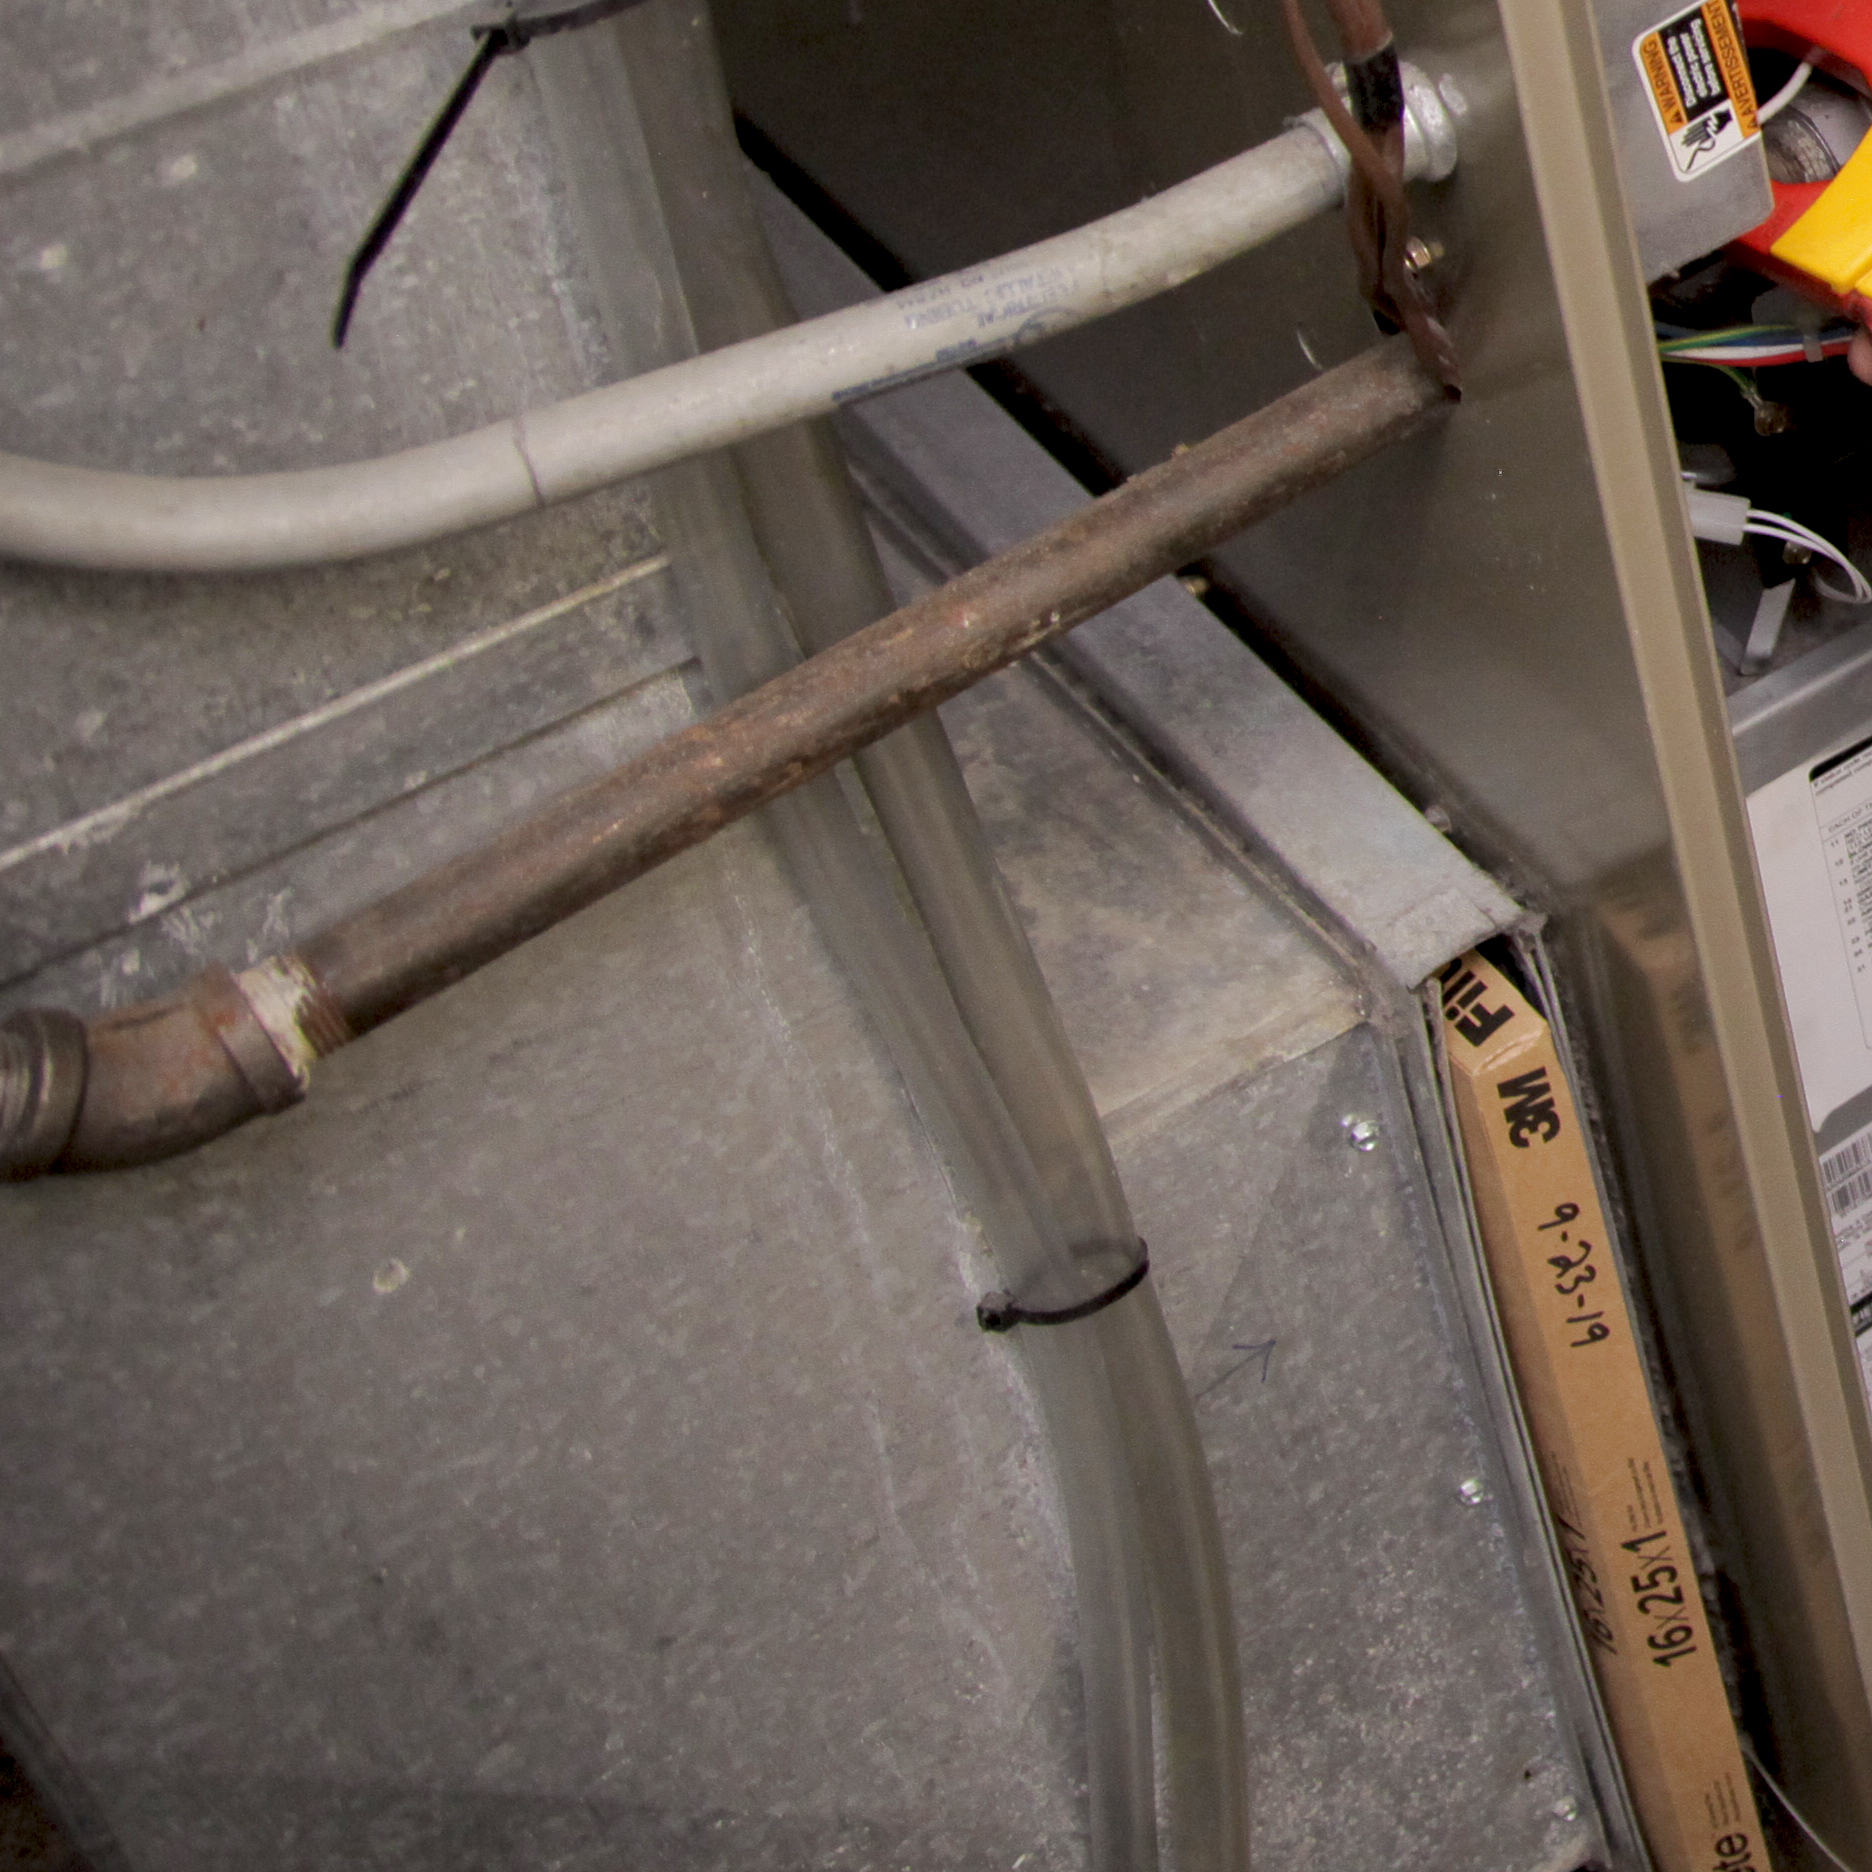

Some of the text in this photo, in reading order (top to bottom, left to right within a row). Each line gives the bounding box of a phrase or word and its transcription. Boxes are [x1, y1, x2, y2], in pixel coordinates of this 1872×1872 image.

[1642, 40, 1677, 113] WARNING
[1666, 36, 1697, 109] Disconnect the
[1679, 32, 1709, 98] electric power
[1704, 62, 1722, 98] before
[1496, 1065, 1562, 1149] 3M
[1537, 1201, 1611, 1348] 9-23-19
